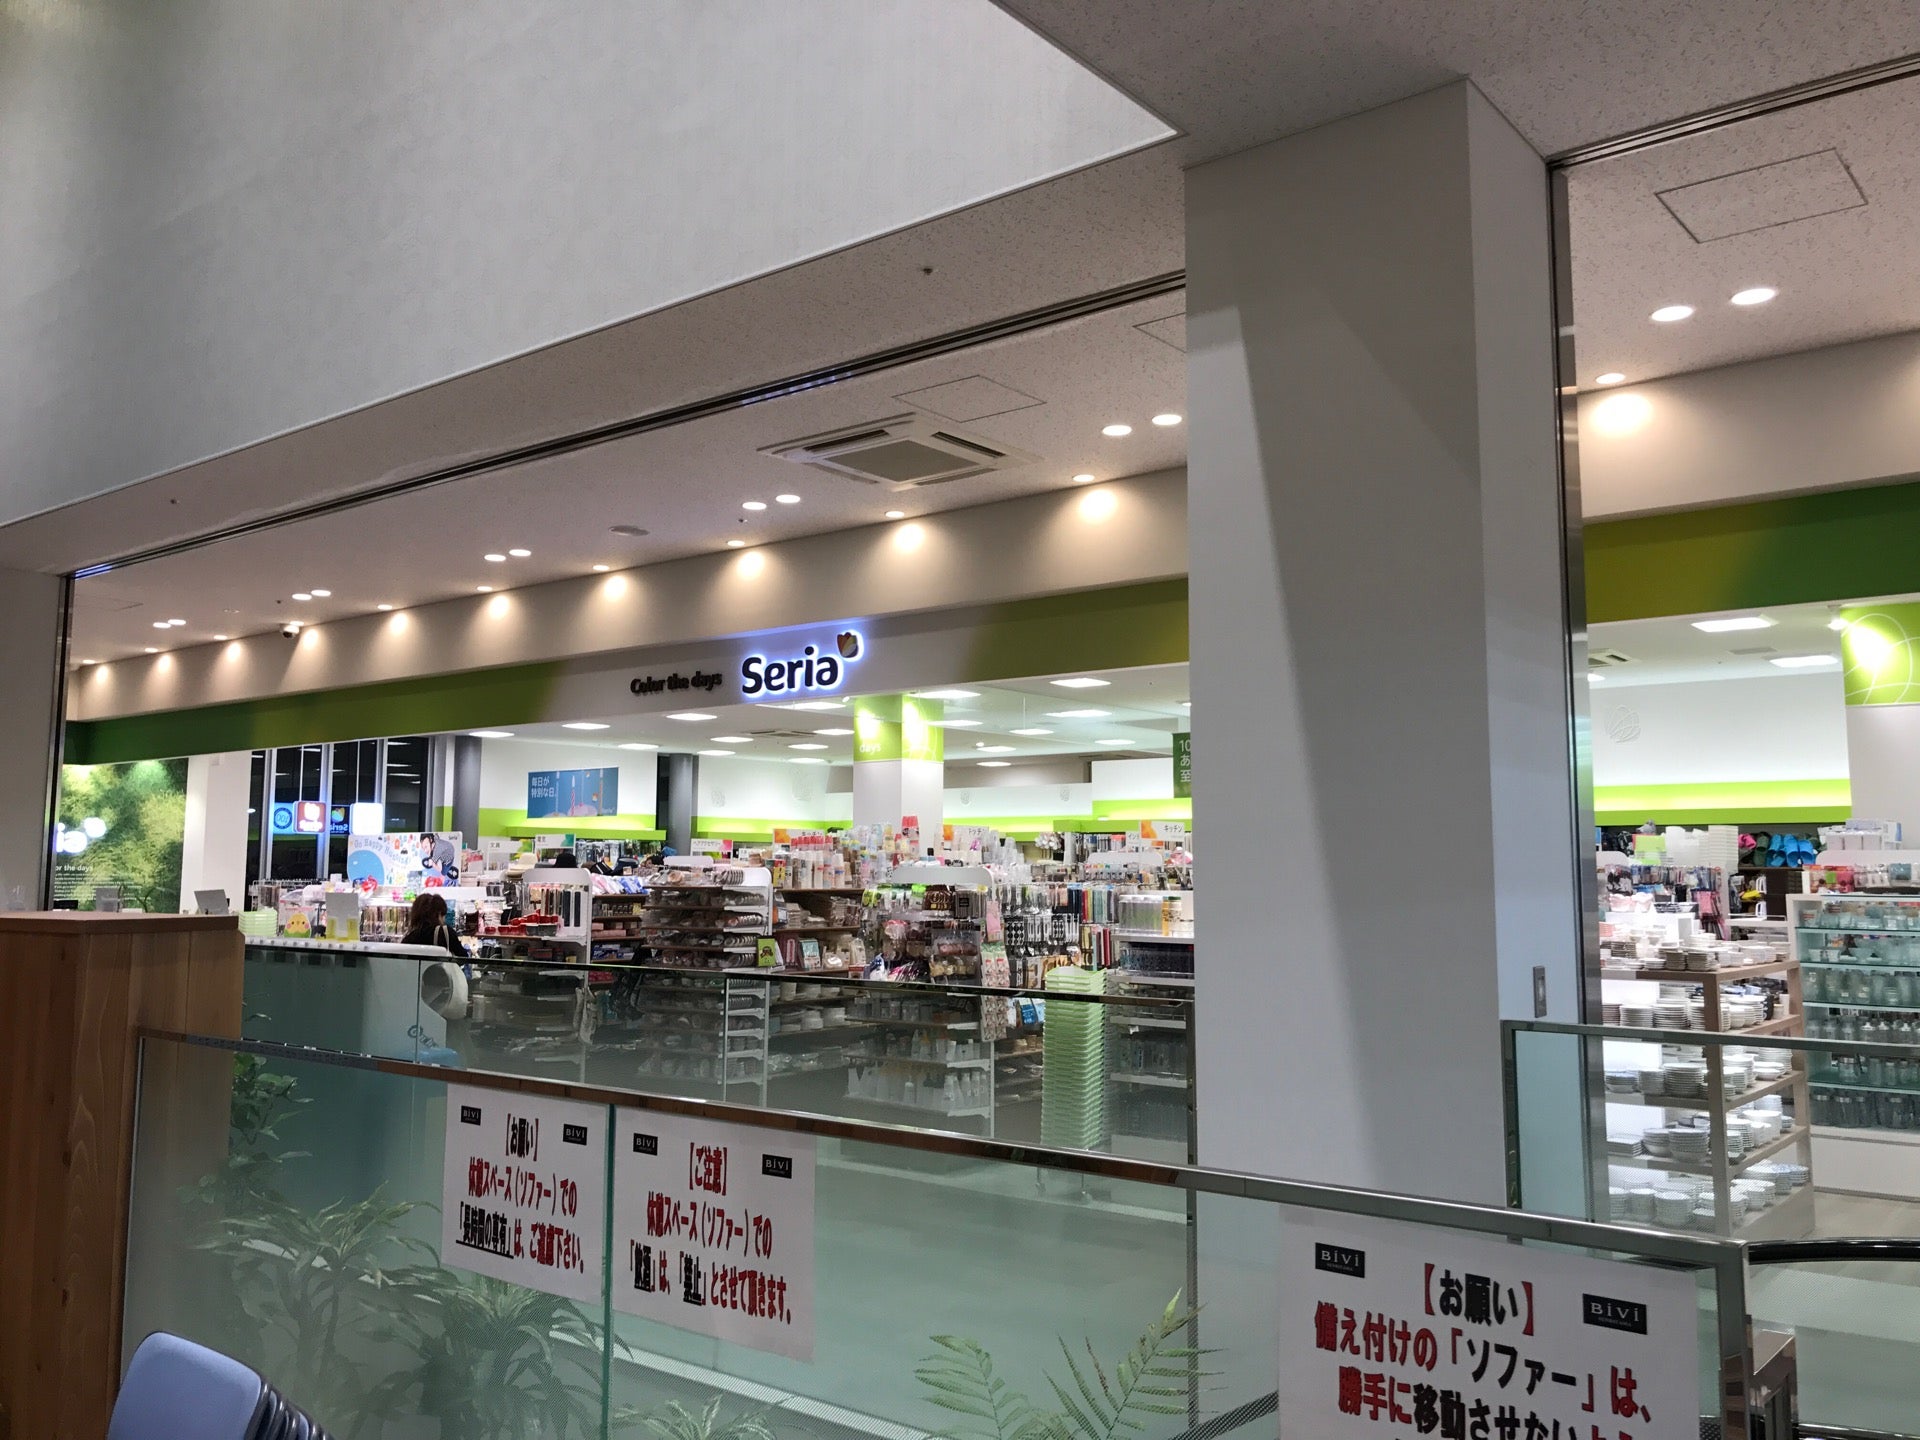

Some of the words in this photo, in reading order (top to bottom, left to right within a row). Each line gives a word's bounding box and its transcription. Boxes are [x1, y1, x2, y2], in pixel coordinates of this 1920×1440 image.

[630, 676, 666, 693] Color
[667, 673, 690, 690] the
[691, 671, 722, 691] days
[742, 646, 839, 694] Seria
[506, 1113, 539, 1161] 【お願い】
[690, 1142, 727, 1196] 【ご注意】
[1321, 1250, 1360, 1268] BiVi
[1424, 1262, 1535, 1337] 【お願い】
[1591, 1302, 1640, 1322] BiVi
[1314, 1300, 1652, 1423] 備え付けの「ソファー」は、
